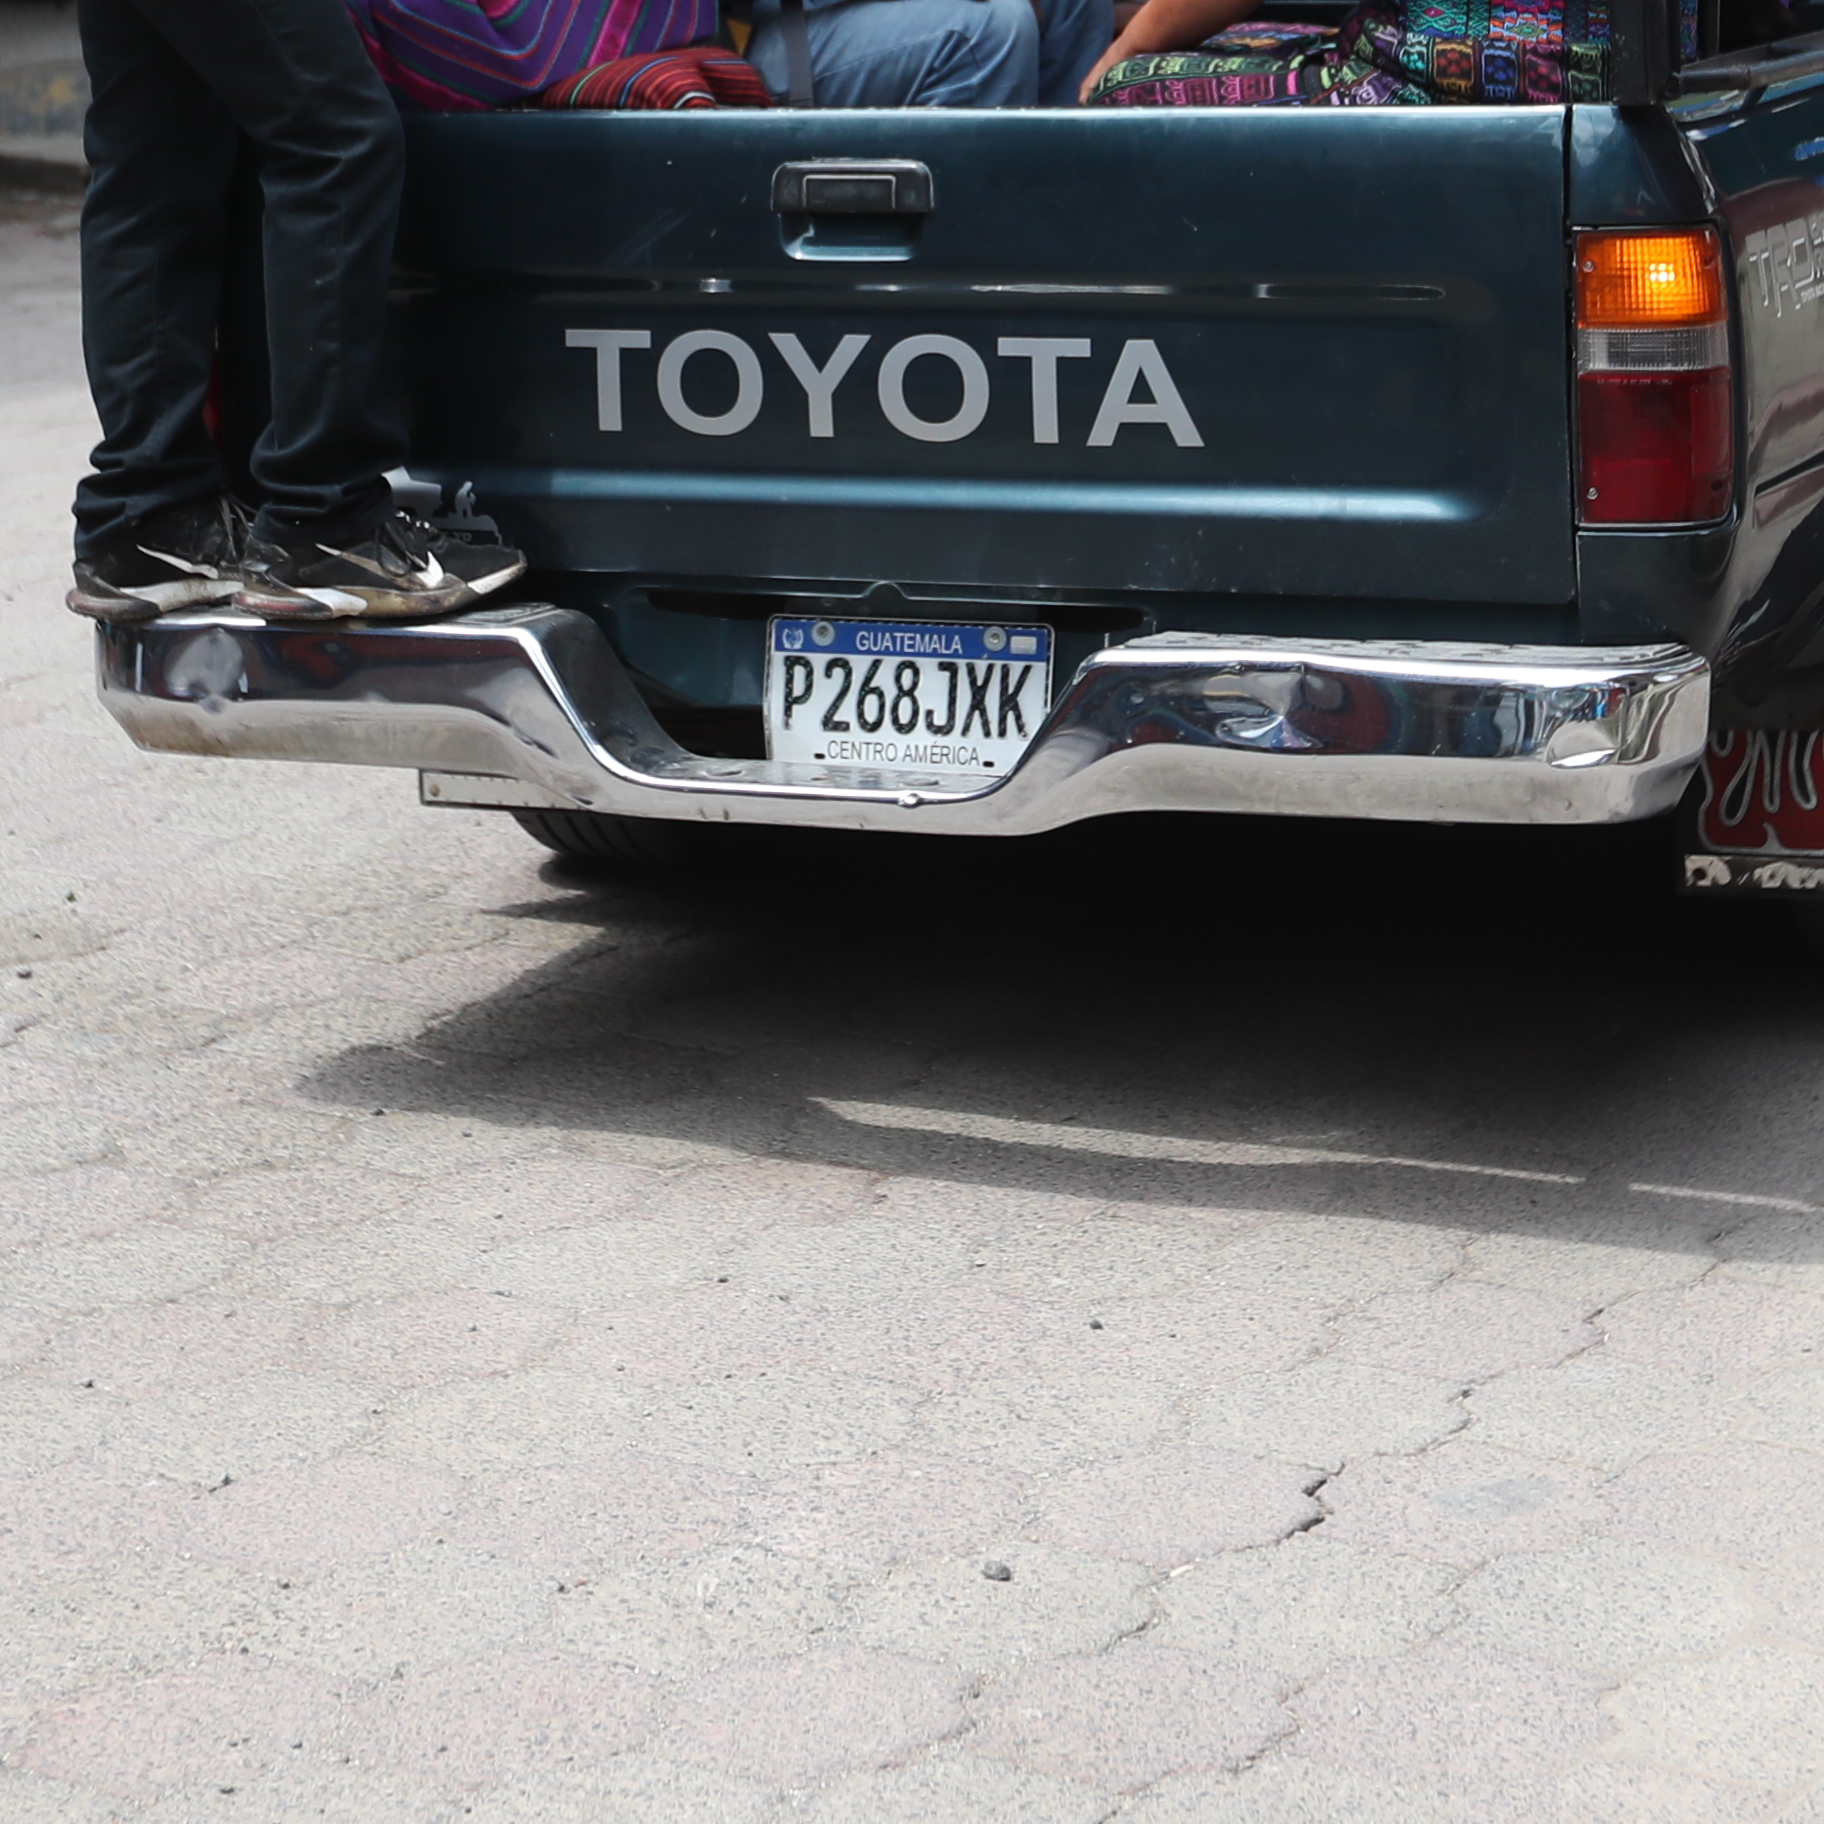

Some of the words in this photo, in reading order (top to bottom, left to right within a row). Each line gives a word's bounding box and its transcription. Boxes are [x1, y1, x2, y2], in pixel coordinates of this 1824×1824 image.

[565, 329, 1205, 447] TOYOTA
[856, 630, 962, 655] GUATEMALA
[783, 654, 1032, 741] P268JXK
[827, 739, 898, 763] CENTRO
[902, 740, 980, 767] AMÉRICA
